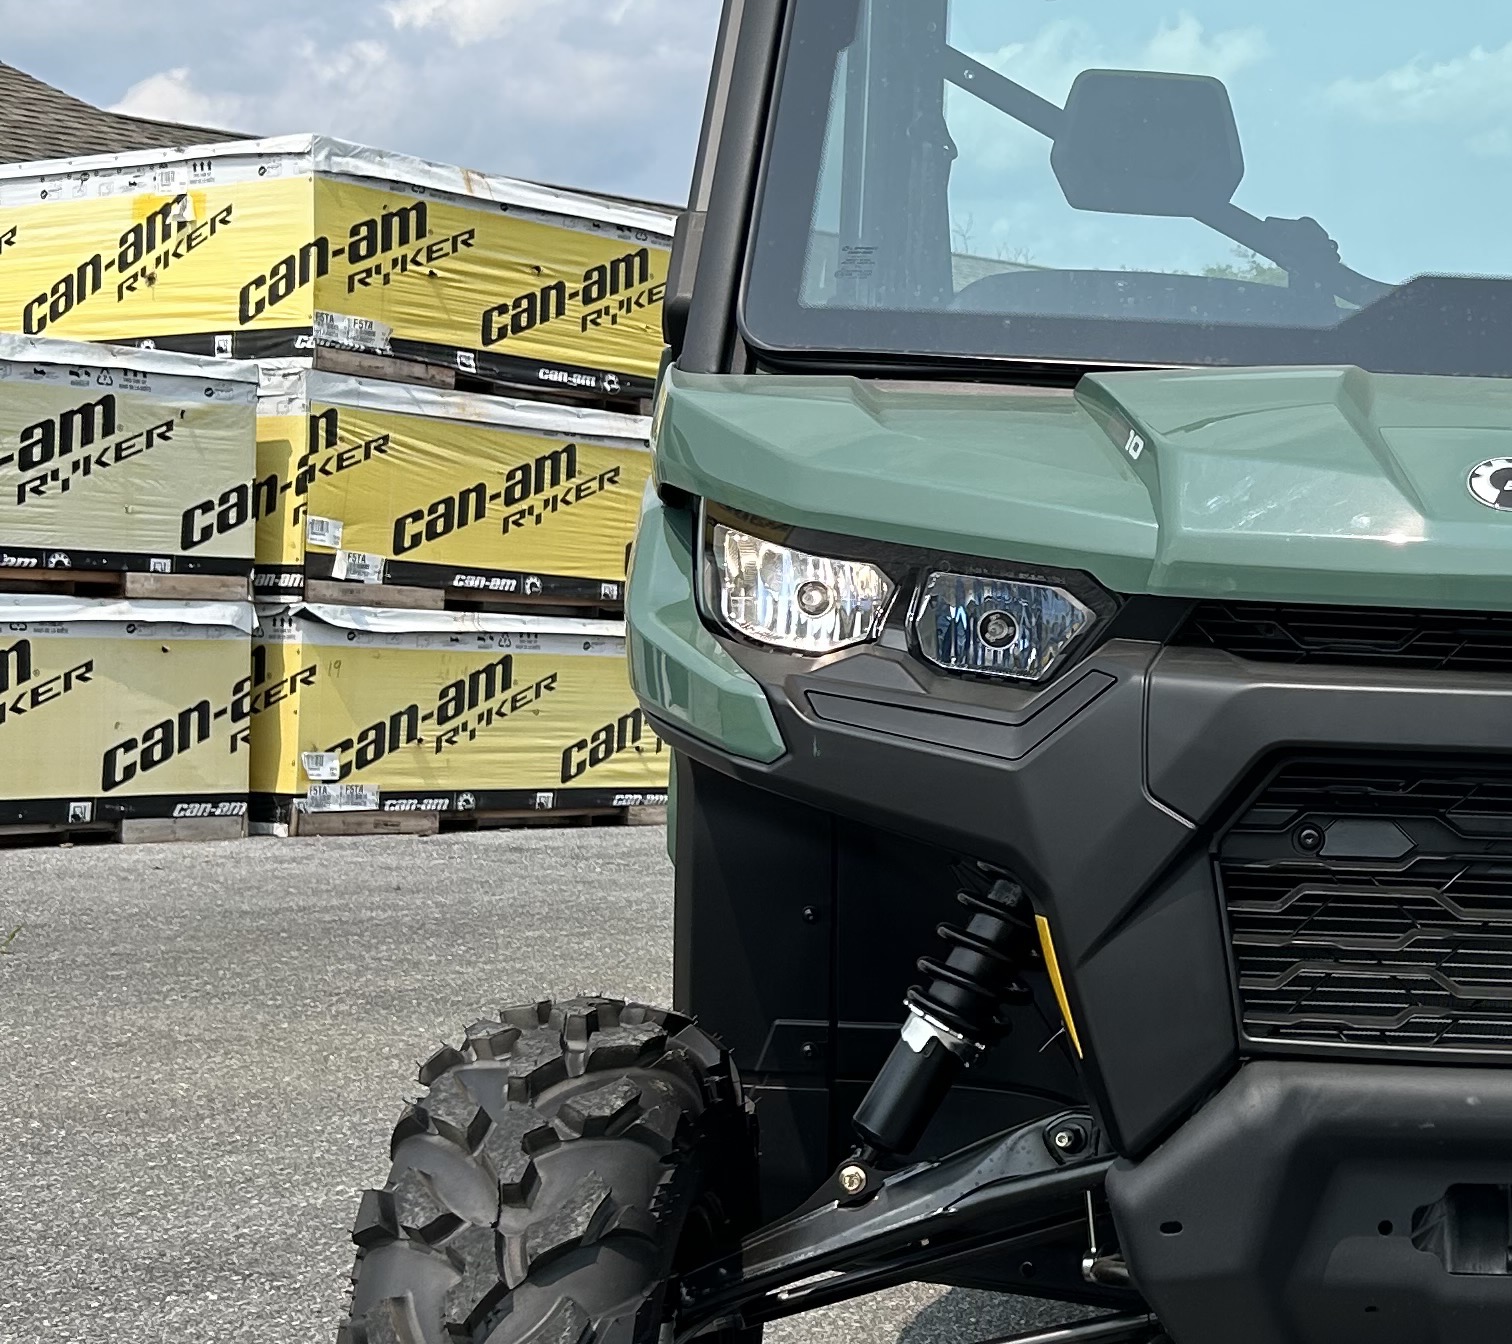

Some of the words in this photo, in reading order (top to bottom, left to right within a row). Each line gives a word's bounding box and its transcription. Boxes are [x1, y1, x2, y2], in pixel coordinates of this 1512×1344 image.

[239, 201, 428, 325] can-am
[348, 228, 475, 294] RYKER
[481, 248, 649, 347] can-am
[581, 282, 667, 333] RYKE
[538, 368, 596, 387] can-am
[0, 394, 116, 472] -am
[17, 419, 174, 505] RYKER
[1124, 429, 1144, 460] 10
[393, 443, 577, 556] can-am
[502, 466, 620, 535] RYKER
[255, 573, 304, 587] an-am
[452, 573, 517, 592] can-am
[435, 672, 558, 755] RYKER
[560, 707, 643, 784] can
[172, 802, 248, 817] can-am
